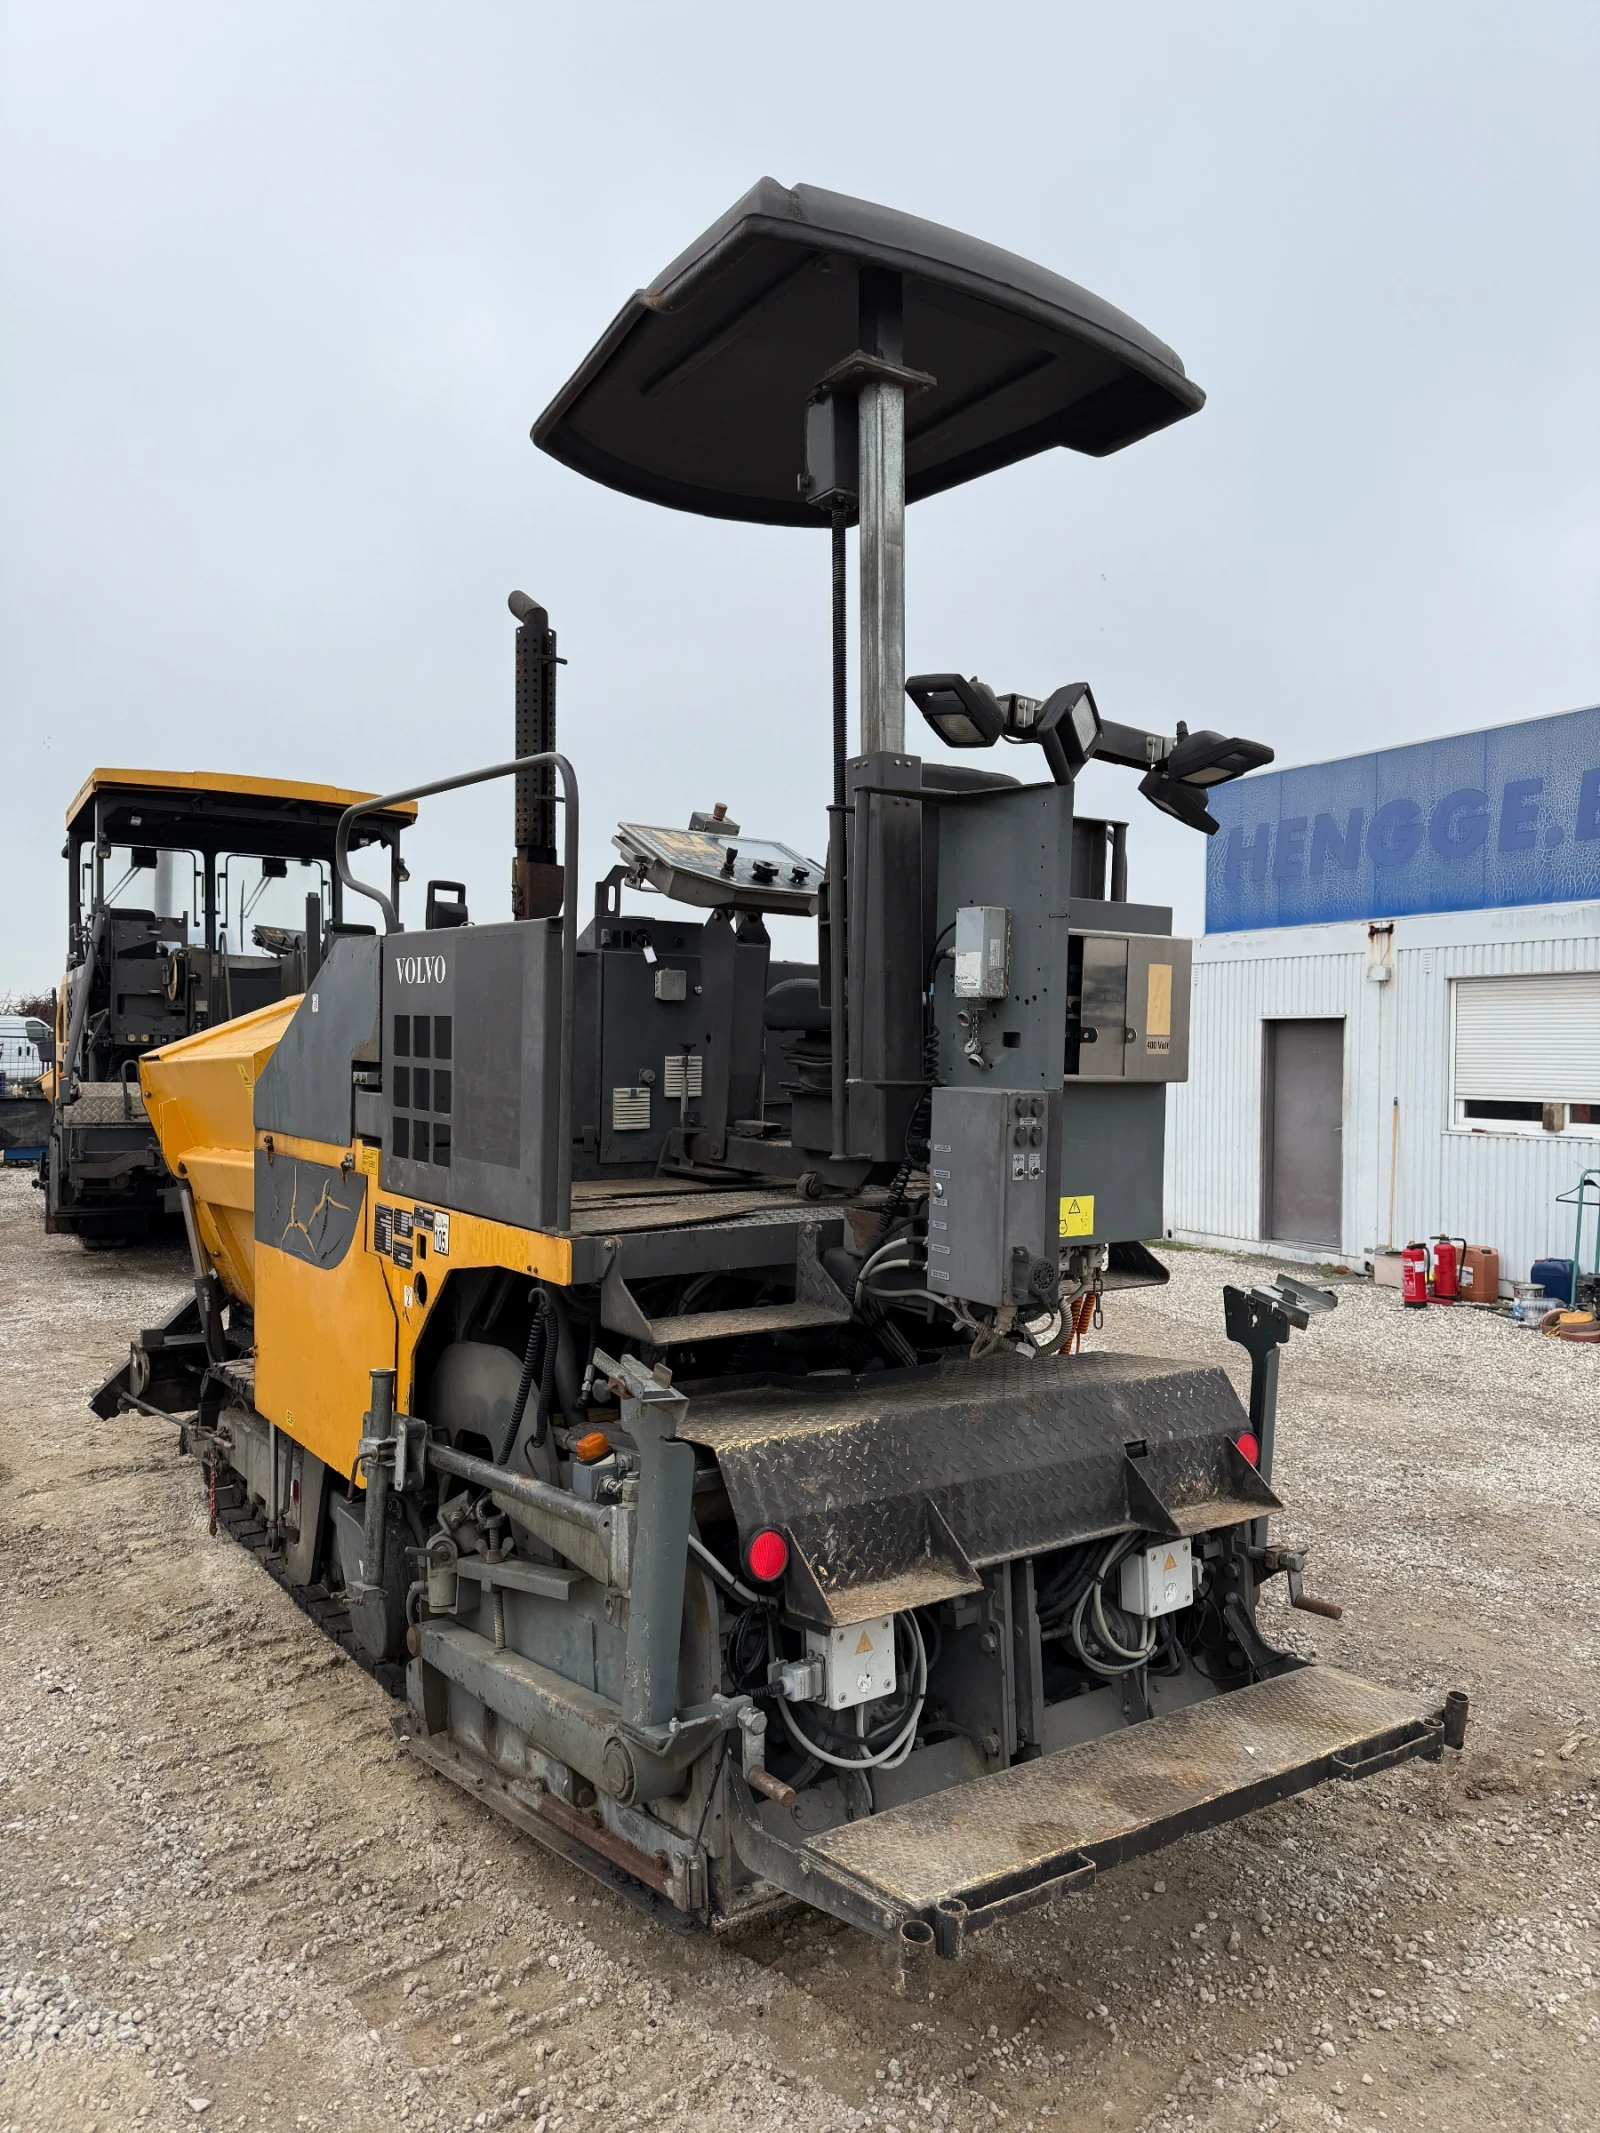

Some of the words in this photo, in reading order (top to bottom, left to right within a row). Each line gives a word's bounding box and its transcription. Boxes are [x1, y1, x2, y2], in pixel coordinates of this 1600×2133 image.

[395, 954, 446, 985] VOLVO
[1147, 1041, 1156, 1049] 400
[1158, 1041, 1169, 1049] Volt
[435, 1229, 446, 1252] 105
